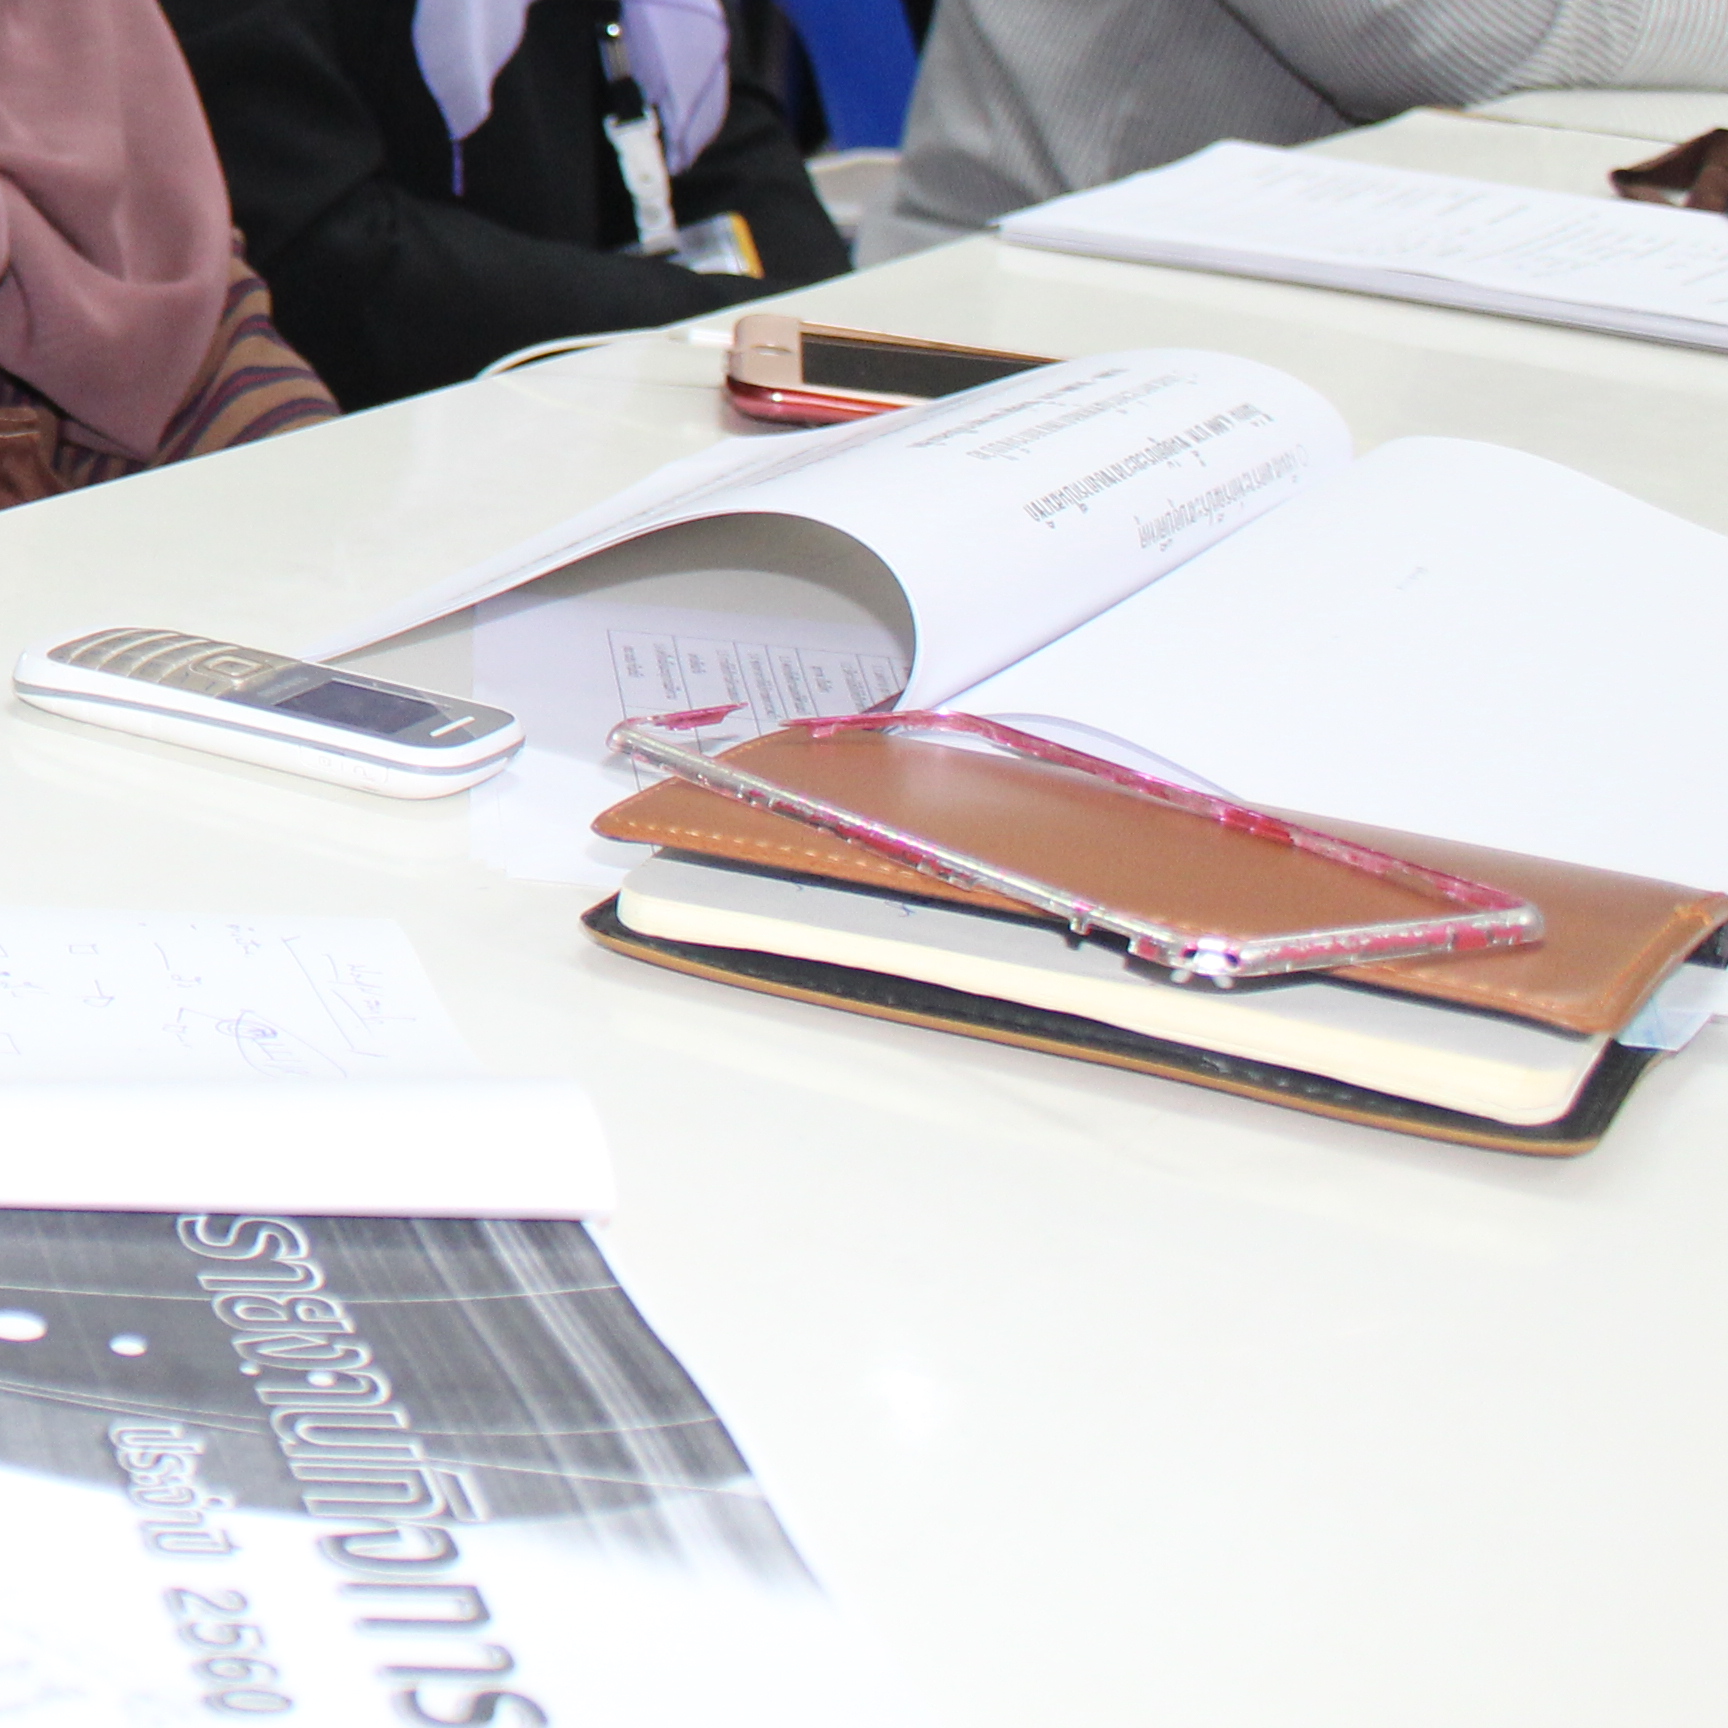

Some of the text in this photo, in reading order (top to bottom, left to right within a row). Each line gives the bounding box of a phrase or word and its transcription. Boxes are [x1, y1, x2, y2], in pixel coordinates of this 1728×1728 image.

[109, 1419, 294, 1715] ประจำปี 2560
[176, 1214, 549, 1728] รายงานกิจการ
